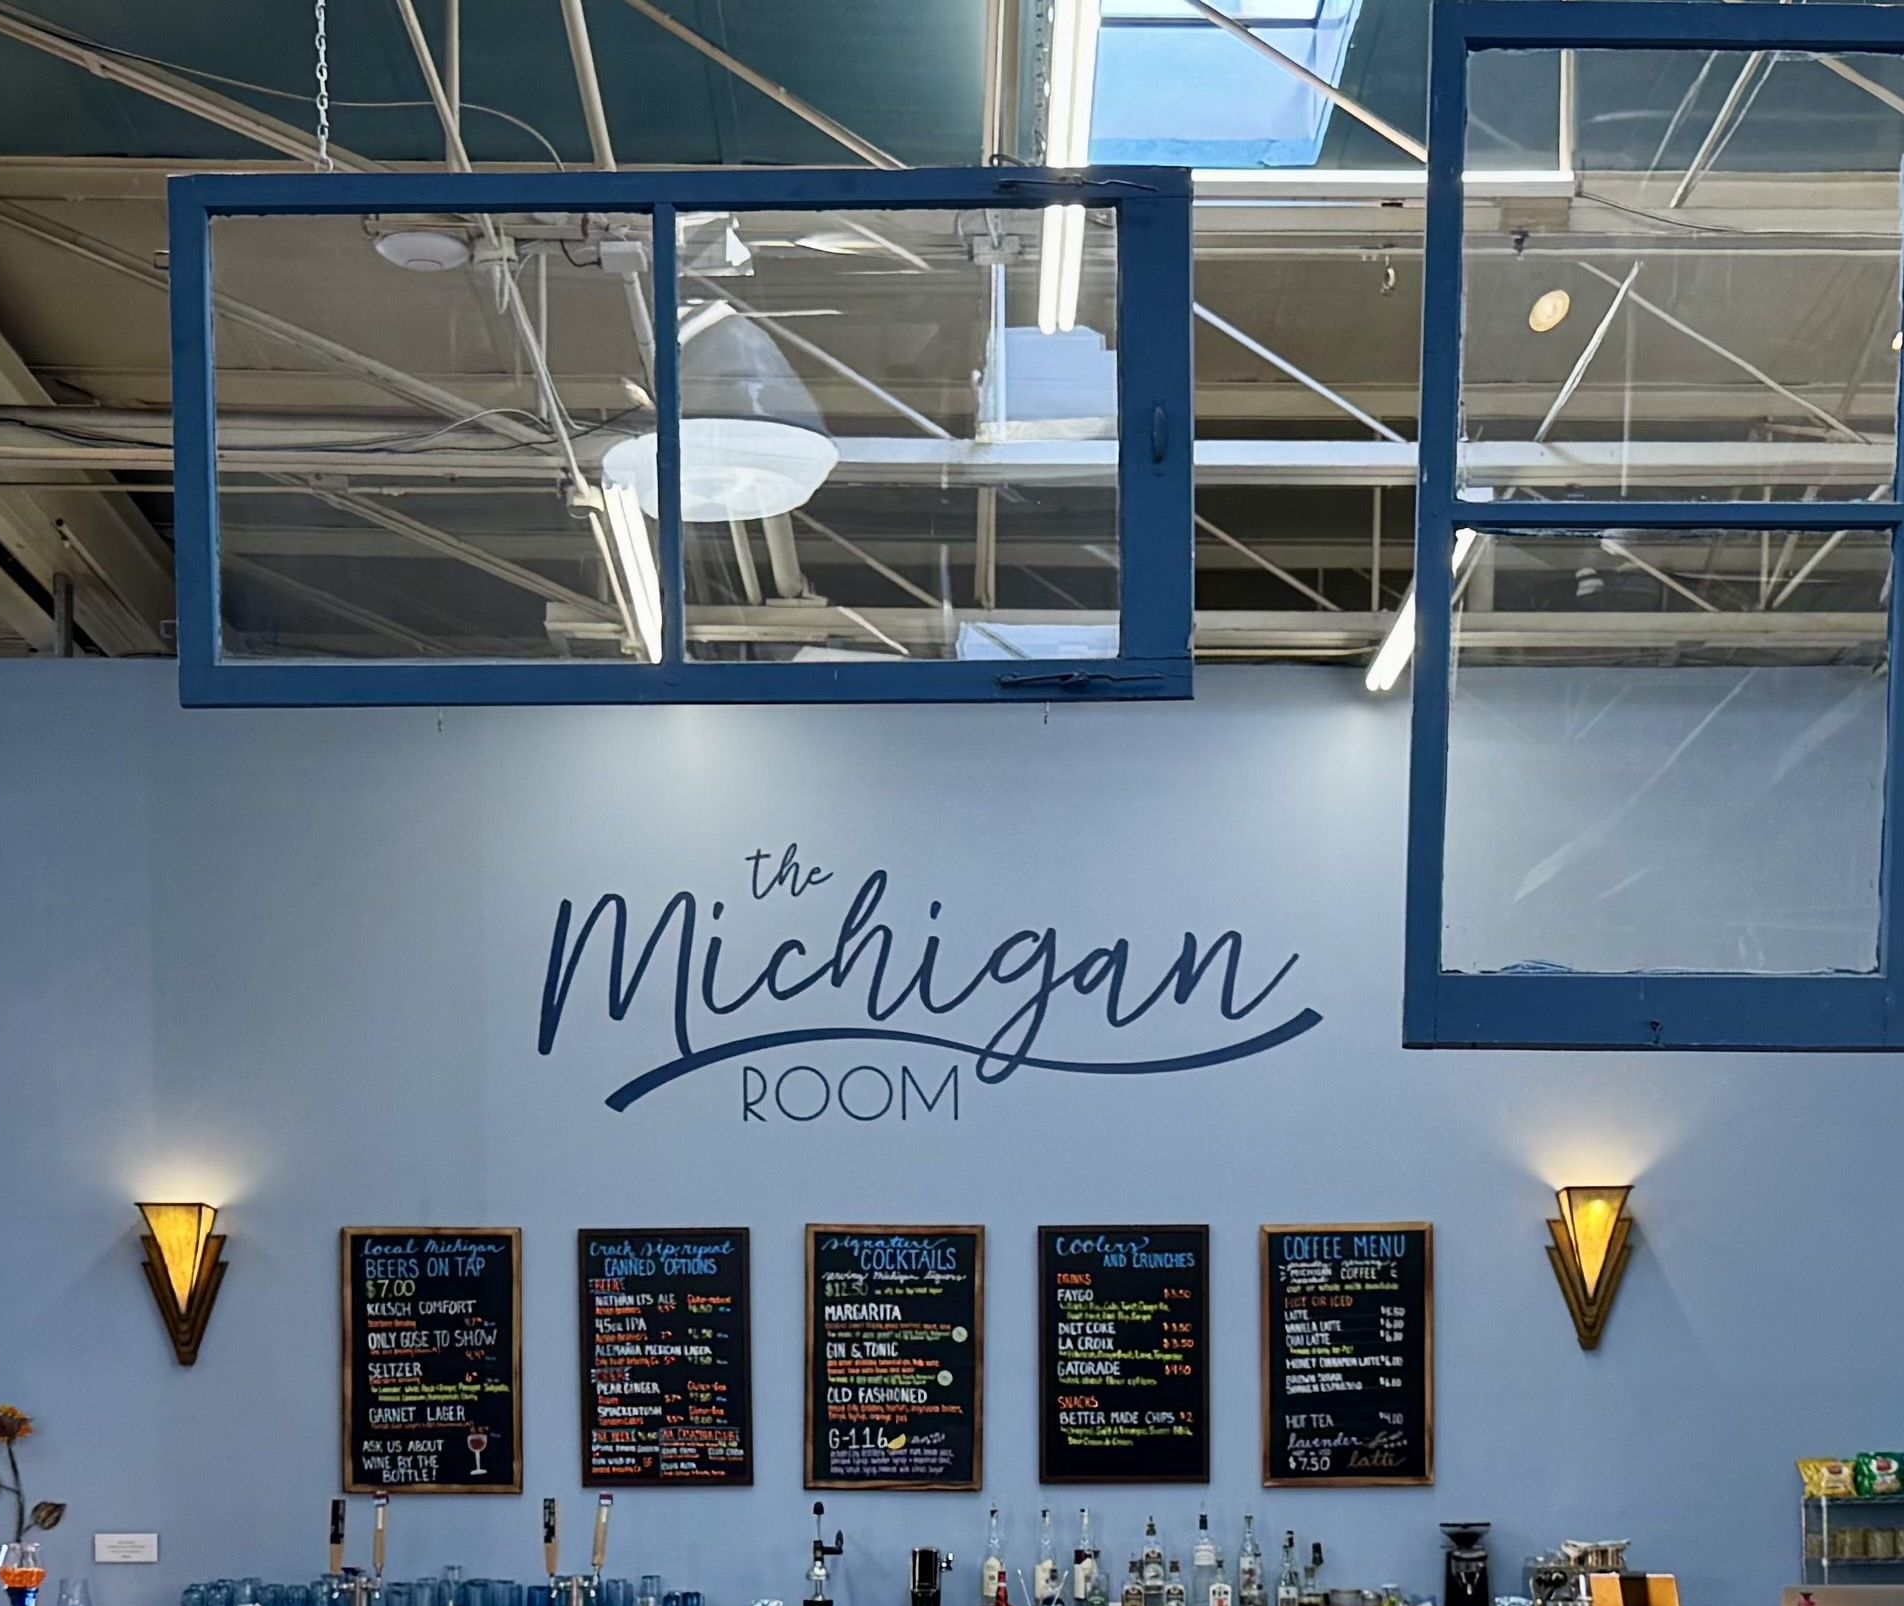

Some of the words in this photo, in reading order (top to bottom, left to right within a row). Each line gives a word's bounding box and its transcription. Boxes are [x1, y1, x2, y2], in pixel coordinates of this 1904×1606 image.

[746, 843, 833, 899] the
[538, 869, 1298, 1084] Michigan
[743, 1064, 958, 1121] ROOM
[1284, 1236, 1342, 1260] COFFEE
[1354, 1235, 1405, 1258] MENU
[861, 1248, 956, 1269] COCKTAILS
[1103, 1254, 1126, 1267] AND
[1133, 1253, 1195, 1268] CRUNCHIES
[366, 1259, 419, 1278] BEERS
[427, 1258, 449, 1277] ON
[455, 1257, 485, 1277] TAP
[605, 1258, 655, 1276] CANNED
[665, 1259, 717, 1274] OPTIONS
[1340, 1268, 1377, 1279] COFFEE
[366, 1279, 415, 1298] $7.00
[1058, 1289, 1094, 1301] FAYGO
[419, 1300, 476, 1314] COMFORT
[1312, 1296, 1327, 1306] OR
[1330, 1295, 1353, 1306] ICED
[825, 1303, 901, 1321] MARGARITA
[1285, 1310, 1308, 1321] LATTE
[626, 1319, 646, 1330] IPA
[1058, 1323, 1084, 1335] DIET
[1086, 1323, 1116, 1334] COKE
[368, 1331, 397, 1349] ONLY
[434, 1331, 449, 1347] TO
[454, 1329, 497, 1347] SHOW
[1059, 1338, 1073, 1350] LA
[1078, 1337, 1113, 1350] CROIX
[827, 1342, 845, 1358] GIN
[851, 1343, 862, 1358] &
[864, 1343, 898, 1356] TONIC
[368, 1362, 422, 1378] SELTZER
[1057, 1361, 1120, 1376] GATORADE
[828, 1387, 852, 1403] OLD
[858, 1387, 927, 1403] FASHIONED
[1058, 1396, 1098, 1408] SNACKS
[369, 1407, 416, 1423] GARNET
[427, 1406, 465, 1421] LAGER
[1060, 1412, 1105, 1424] BETTER
[1111, 1412, 1138, 1424] MADE
[1145, 1412, 1174, 1423] CHIPS
[1286, 1415, 1307, 1429] HOT
[1310, 1415, 1333, 1428] TEA
[829, 1427, 888, 1449] G-116
[1288, 1432, 1362, 1450] lavender
[363, 1441, 383, 1453] ASK
[387, 1441, 401, 1453] US
[408, 1440, 444, 1451] ABOUT
[362, 1456, 391, 1470] WINE
[398, 1457, 412, 1468] BY
[417, 1455, 439, 1468] THE
[1289, 1457, 1330, 1471] $7.50
[383, 1470, 436, 1483] BOTTLE!
